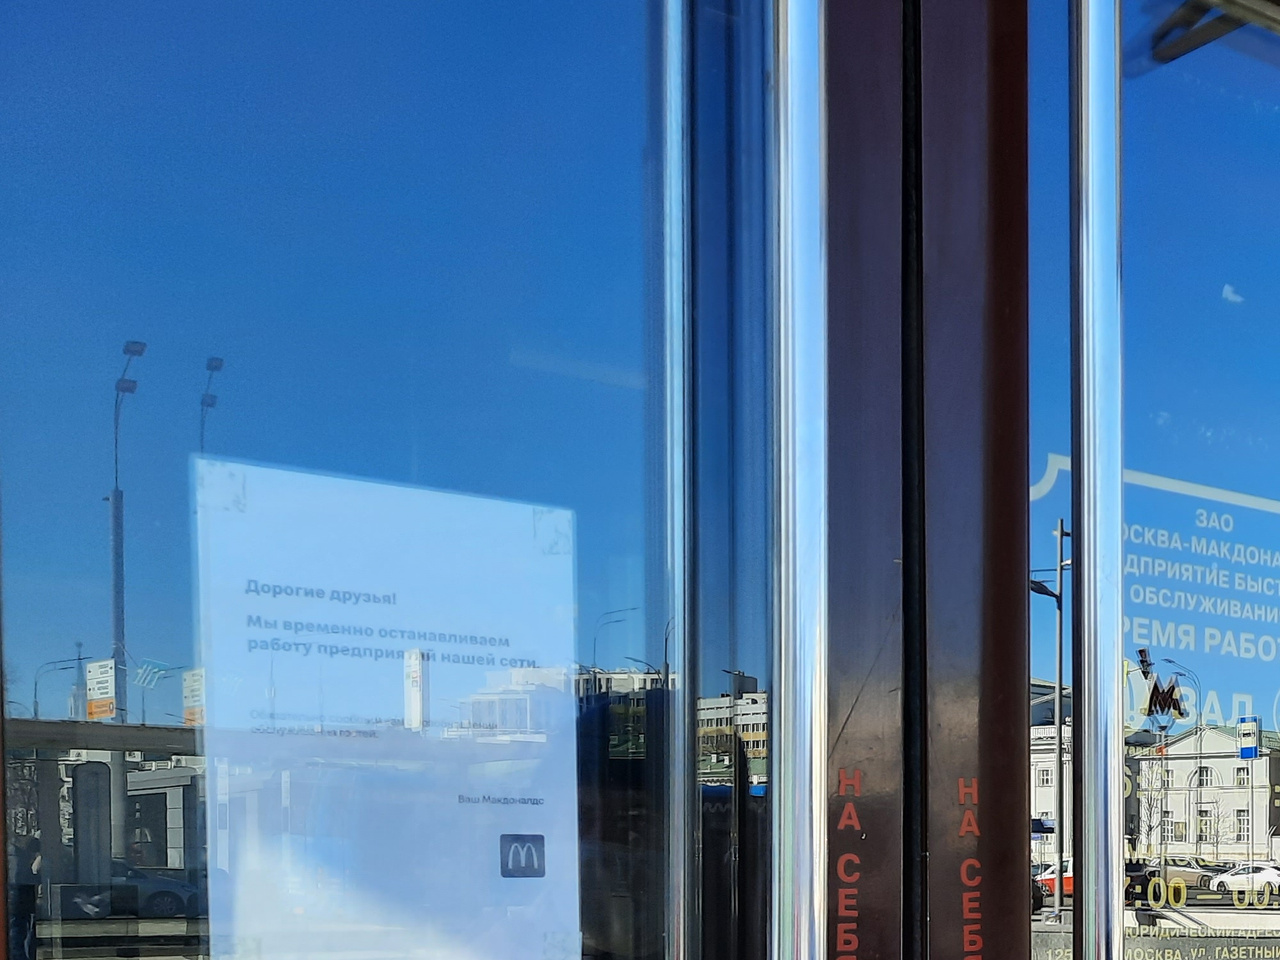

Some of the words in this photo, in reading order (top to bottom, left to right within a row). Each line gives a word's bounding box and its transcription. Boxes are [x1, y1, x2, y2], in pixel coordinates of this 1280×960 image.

[1195, 508, 1234, 533] ЗАО
[1124, 554, 1229, 589] ДПРИЯТИЕ
[245, 579, 325, 599] Дорогие
[329, 588, 397, 605] друзья!
[247, 615, 278, 630] Мы
[283, 620, 374, 637] временно
[379, 628, 510, 648] останавливаем
[248, 638, 312, 657] работу
[441, 653, 496, 667] нашей
[500, 657, 541, 669] сети.
[458, 794, 480, 805] Ваш
[482, 795, 544, 806] Макдоналдс
[837, 768, 863, 832] НА
[957, 777, 981, 838] НА
